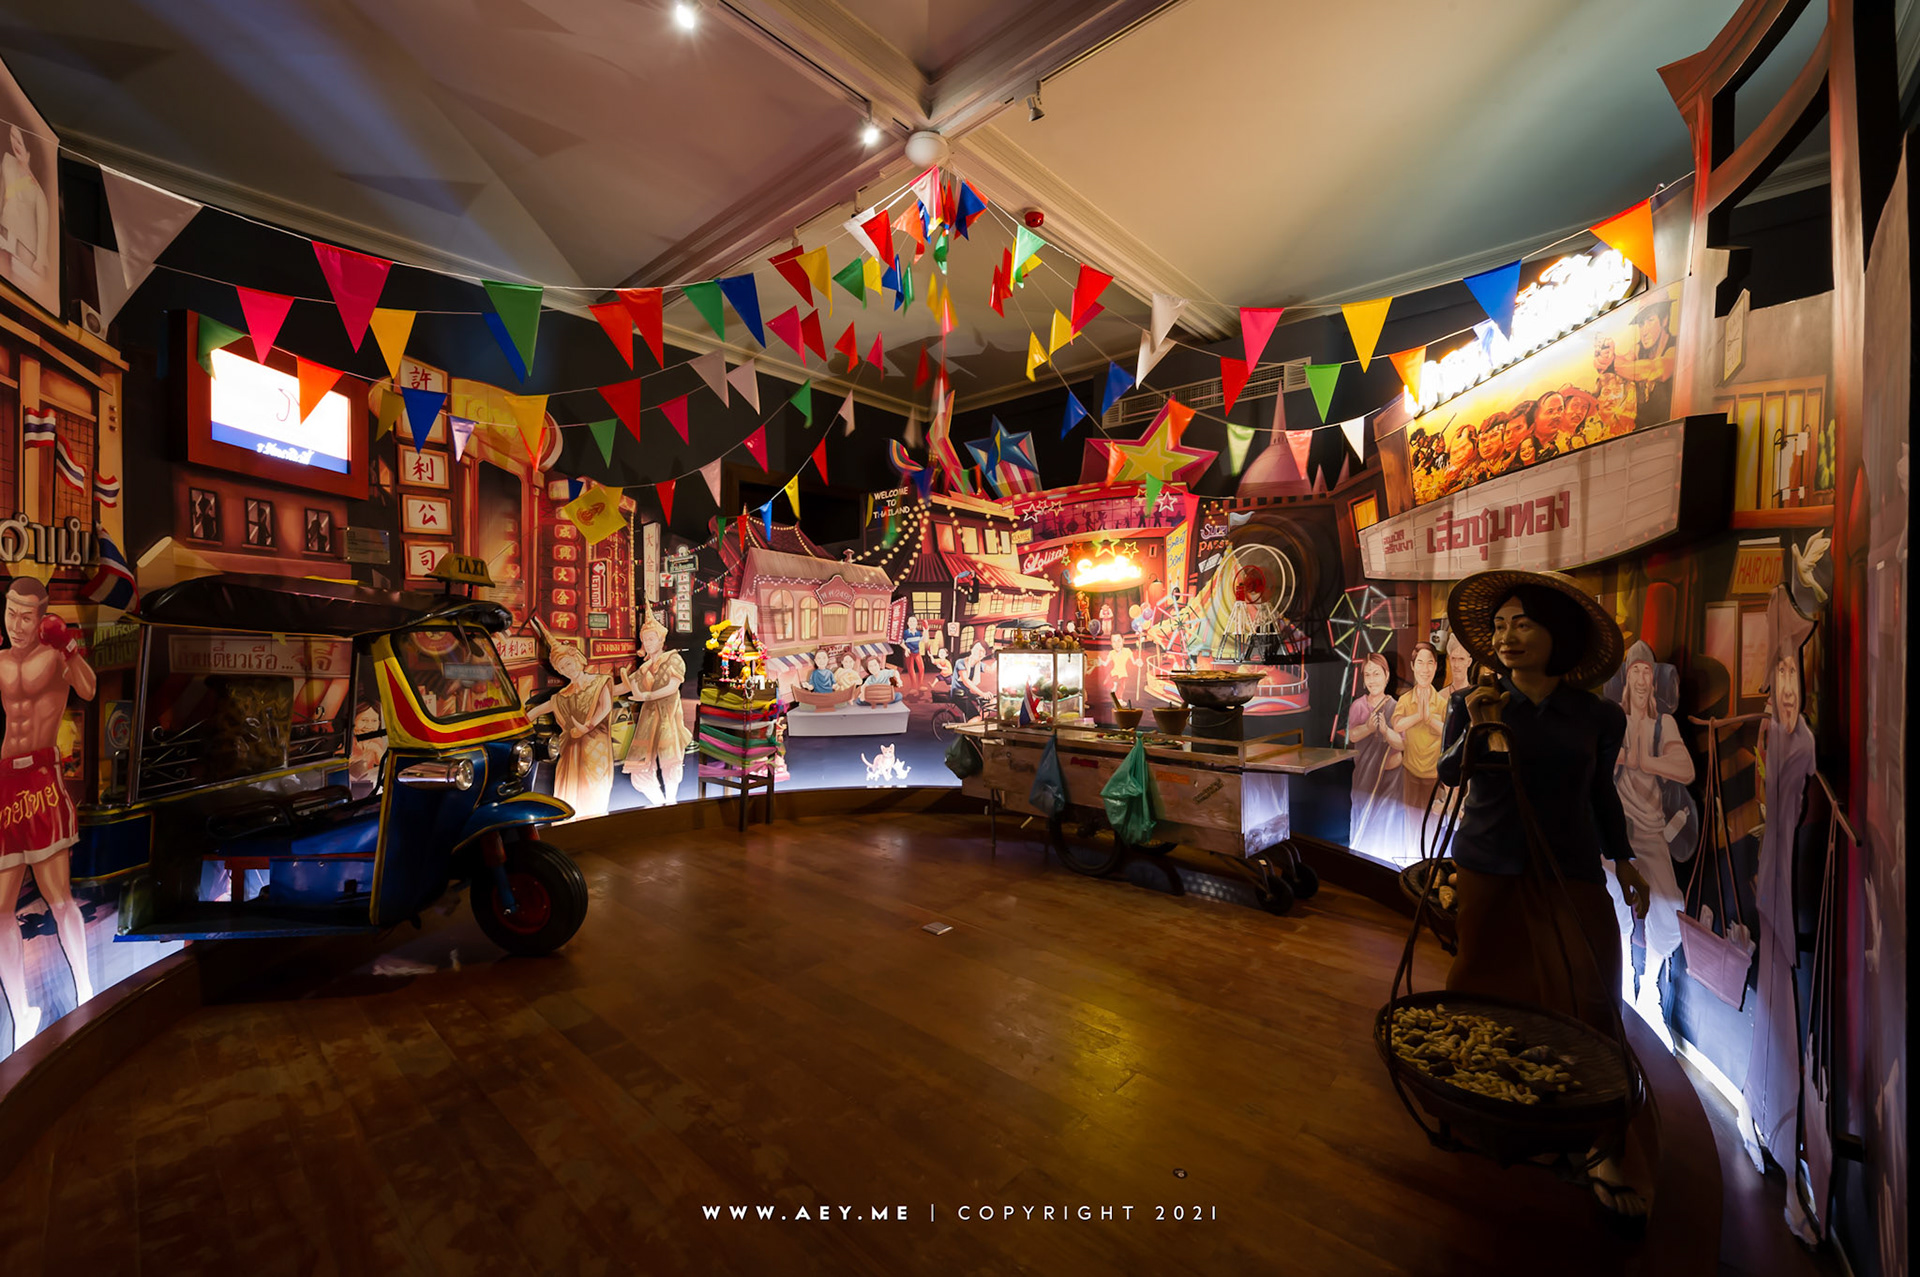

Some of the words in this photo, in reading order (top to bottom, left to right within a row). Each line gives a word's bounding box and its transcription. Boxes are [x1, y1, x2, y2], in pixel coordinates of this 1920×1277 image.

[873, 486, 909, 500] WELCOME
[886, 498, 897, 507] TO
[873, 505, 911, 519] THAILAND
[1426, 489, 1571, 561] เสือชุมทอง
[456, 556, 486, 577] TAXI
[1737, 556, 1761, 584] HAIR
[1762, 556, 1782, 584] CUT
[0, 782, 60, 830] วยไทย
